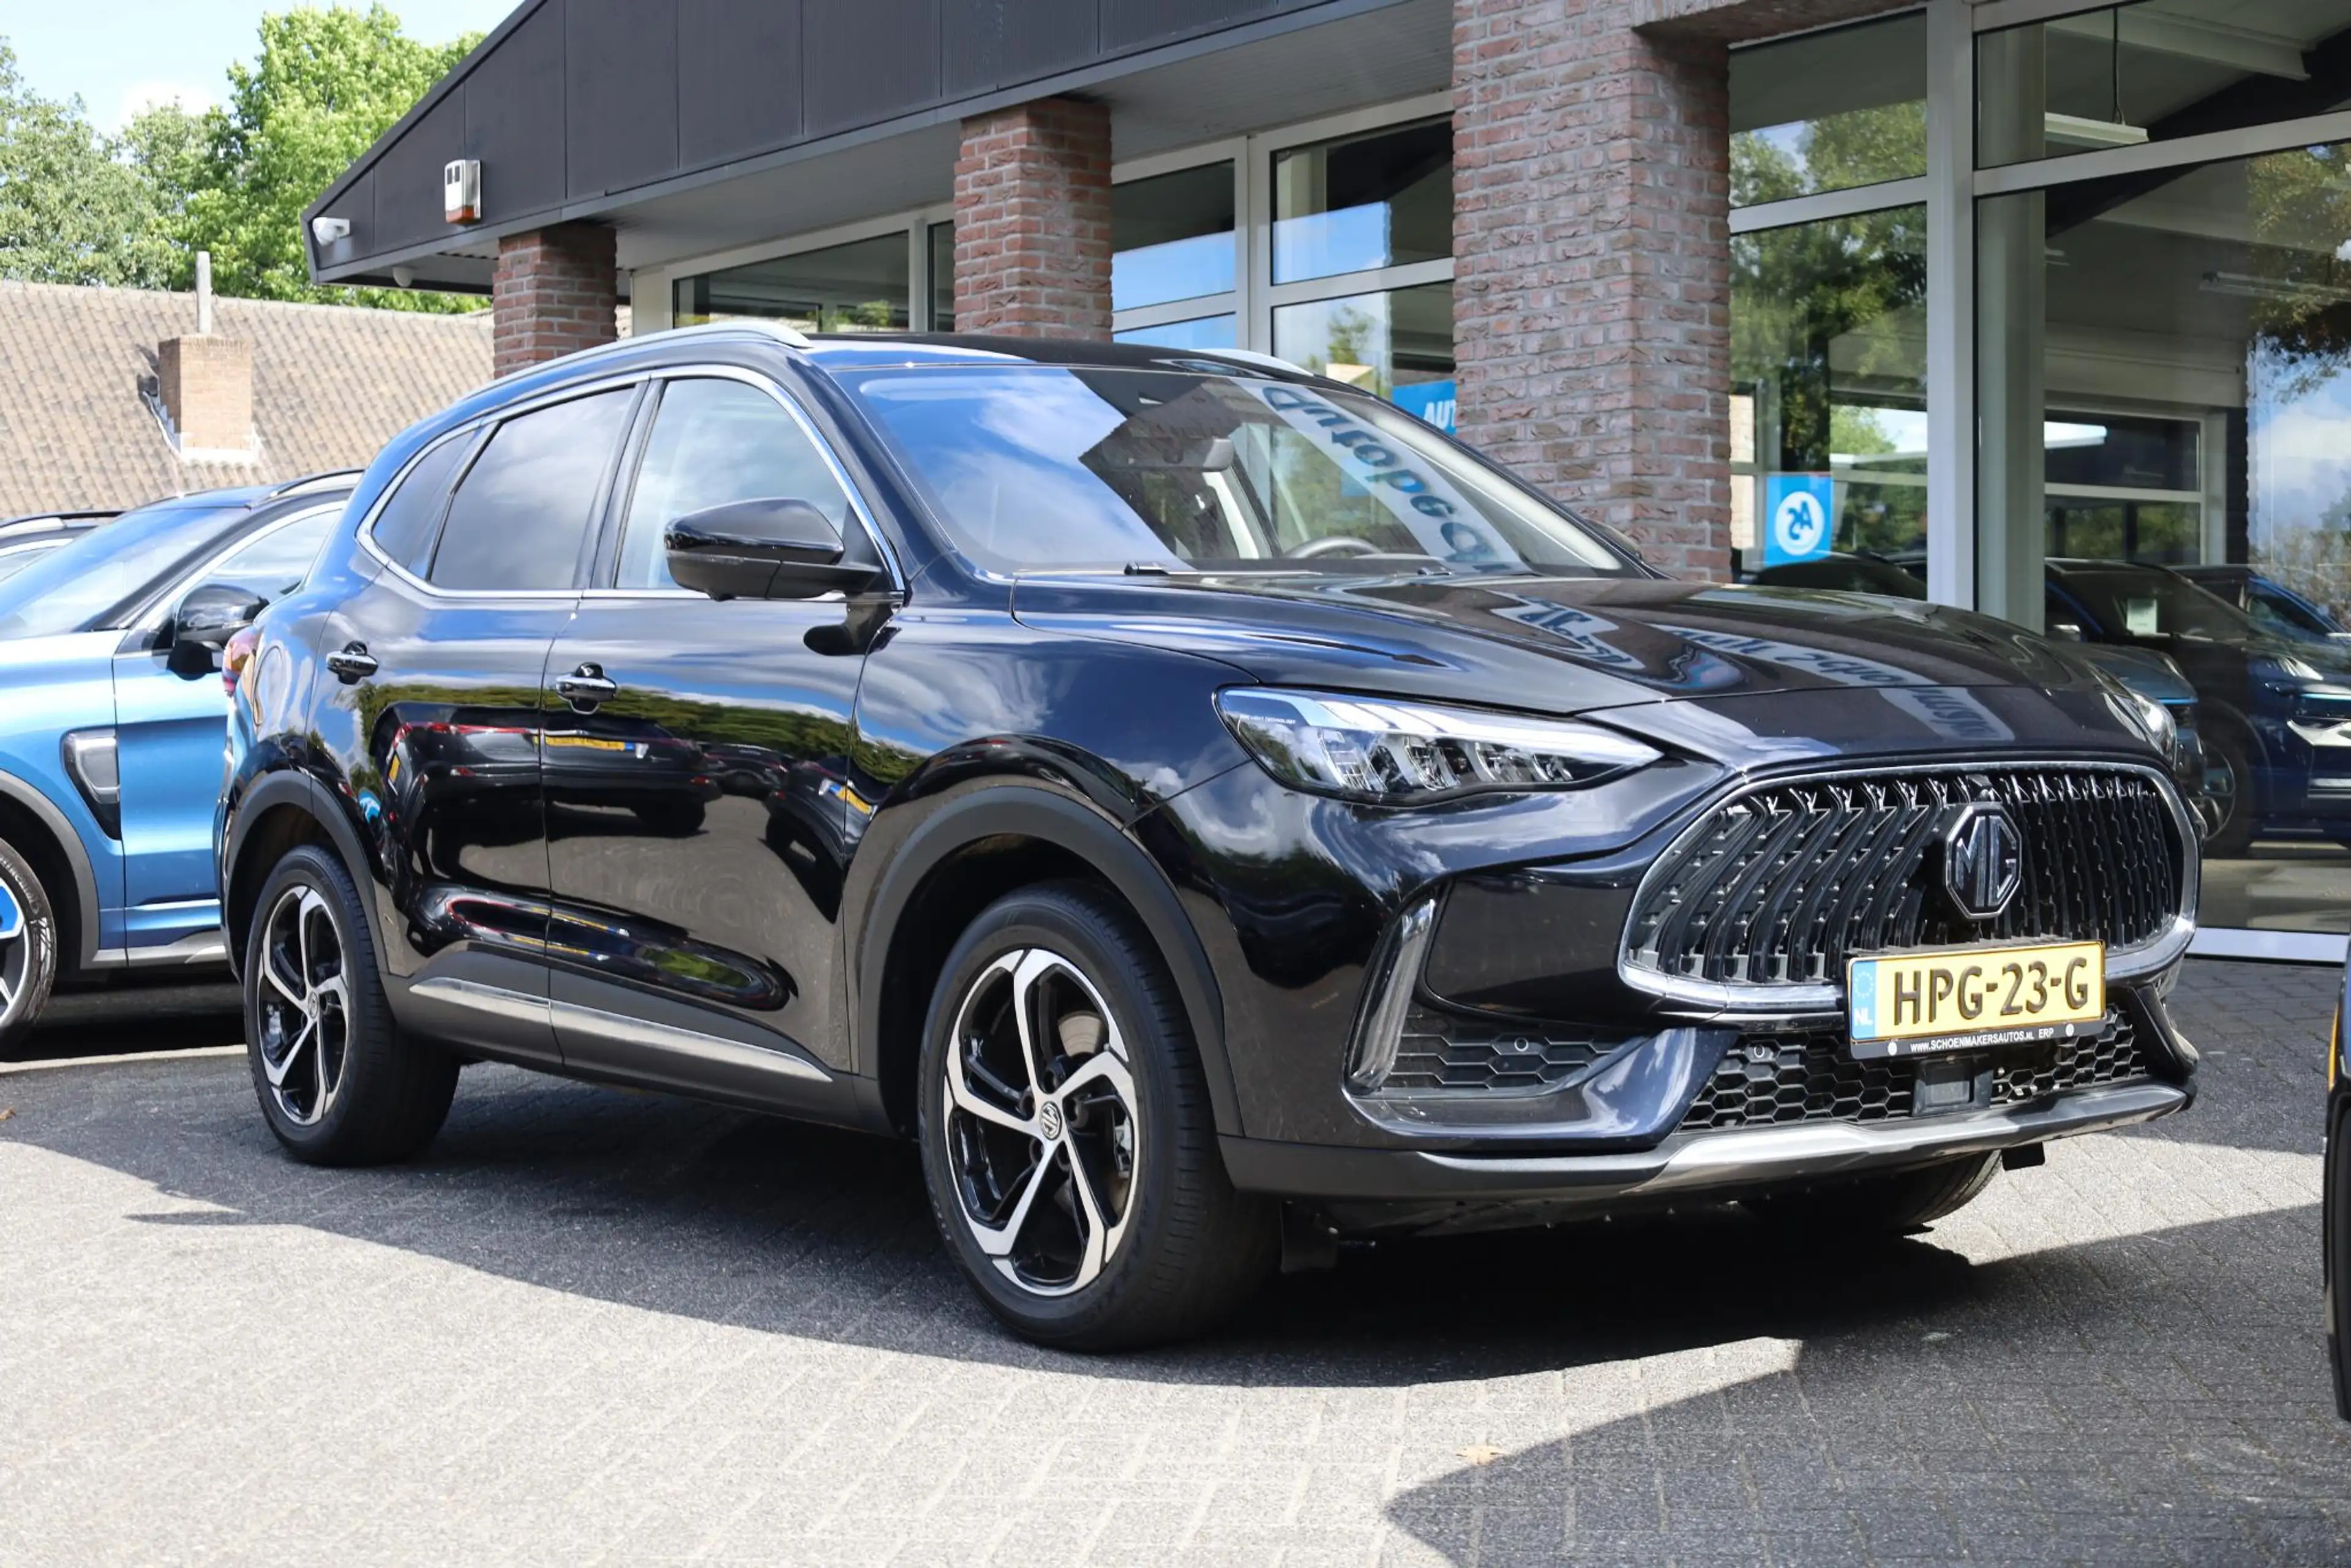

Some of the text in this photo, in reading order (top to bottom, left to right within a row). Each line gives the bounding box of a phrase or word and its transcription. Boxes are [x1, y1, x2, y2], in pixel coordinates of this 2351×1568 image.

[1955, 815, 2017, 907] MG
[1894, 956, 2088, 1026] HPG-23-G
[1853, 1007, 1874, 1027] NL
[2038, 1027, 2054, 1039] ERP
